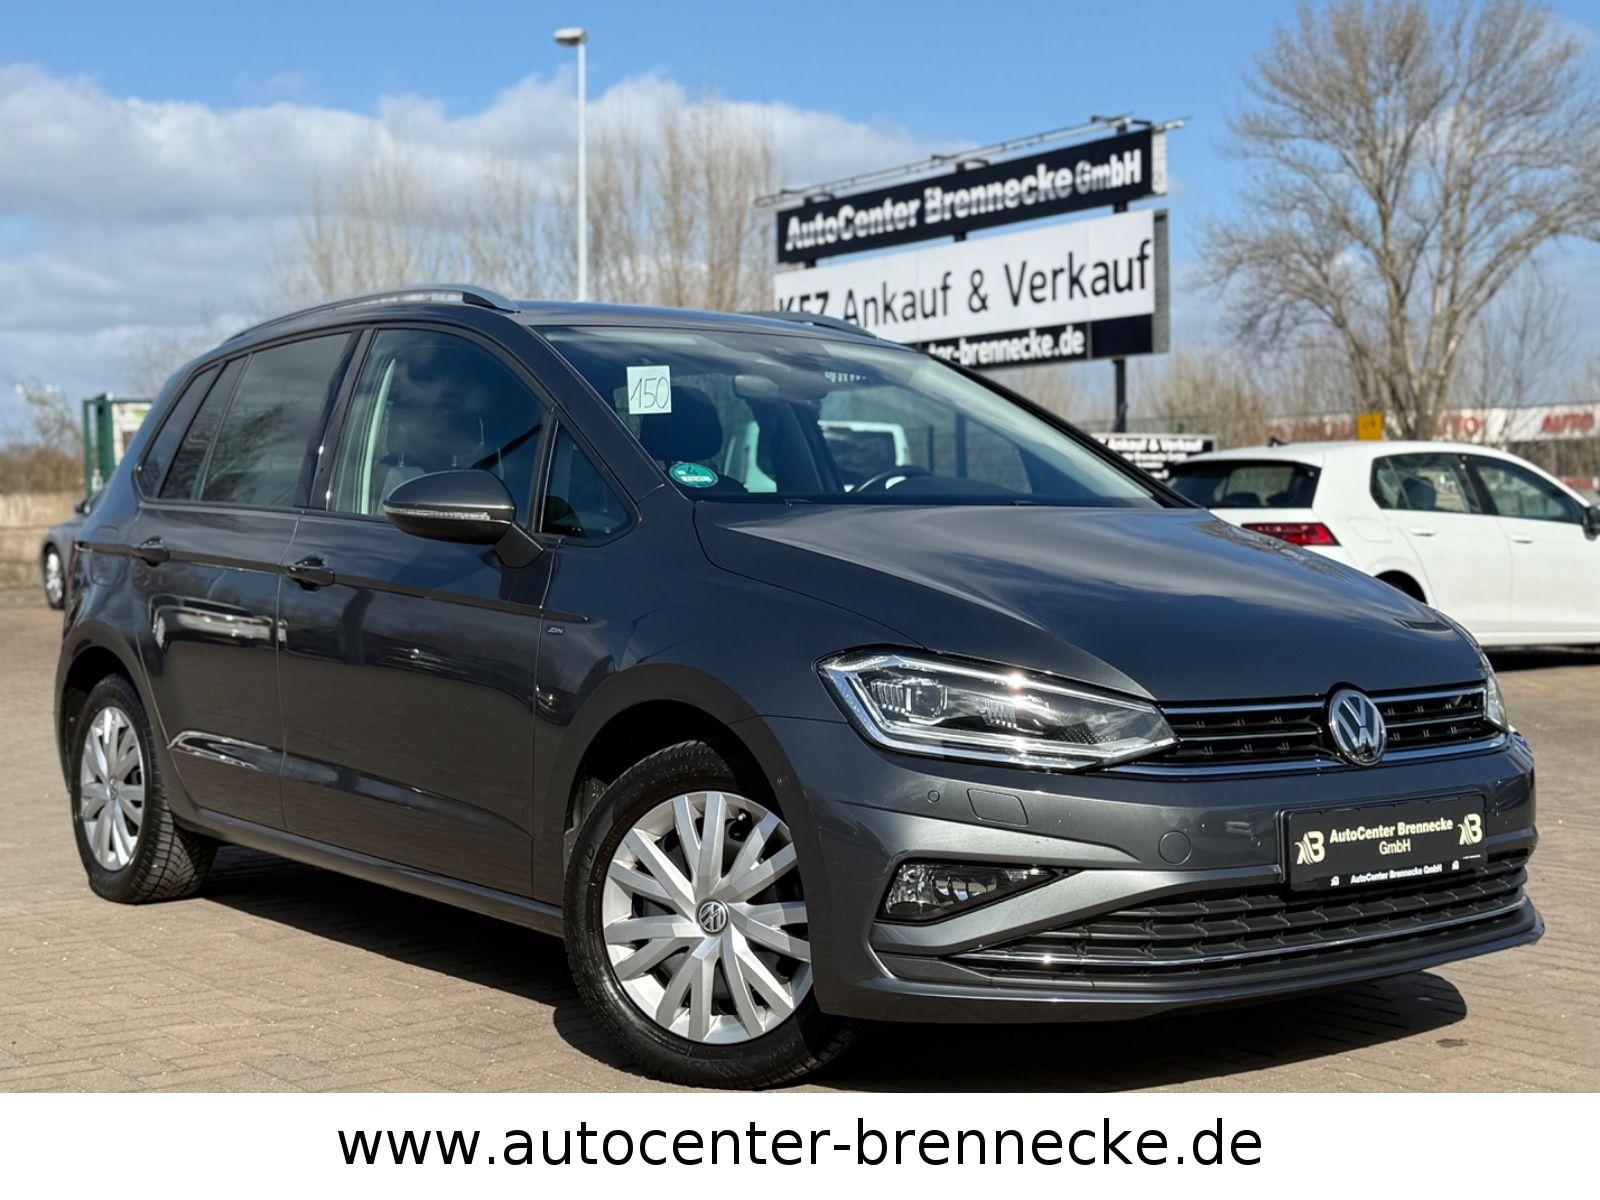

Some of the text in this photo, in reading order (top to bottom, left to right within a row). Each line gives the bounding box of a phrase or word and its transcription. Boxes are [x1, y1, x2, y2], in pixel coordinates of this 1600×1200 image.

[785, 148, 1142, 251] AutoCenter Brennecke GmbH
[843, 271, 953, 330] Ankauf
[968, 268, 989, 313] &
[1004, 239, 1152, 307] Verkauf
[630, 376, 670, 409] 150
[1329, 824, 1396, 844] AutoCenter
[1397, 817, 1453, 836] Brennecke
[1379, 838, 1412, 855] GmbH
[1350, 863, 1443, 884] AutoCenter Brennecke GmbH
